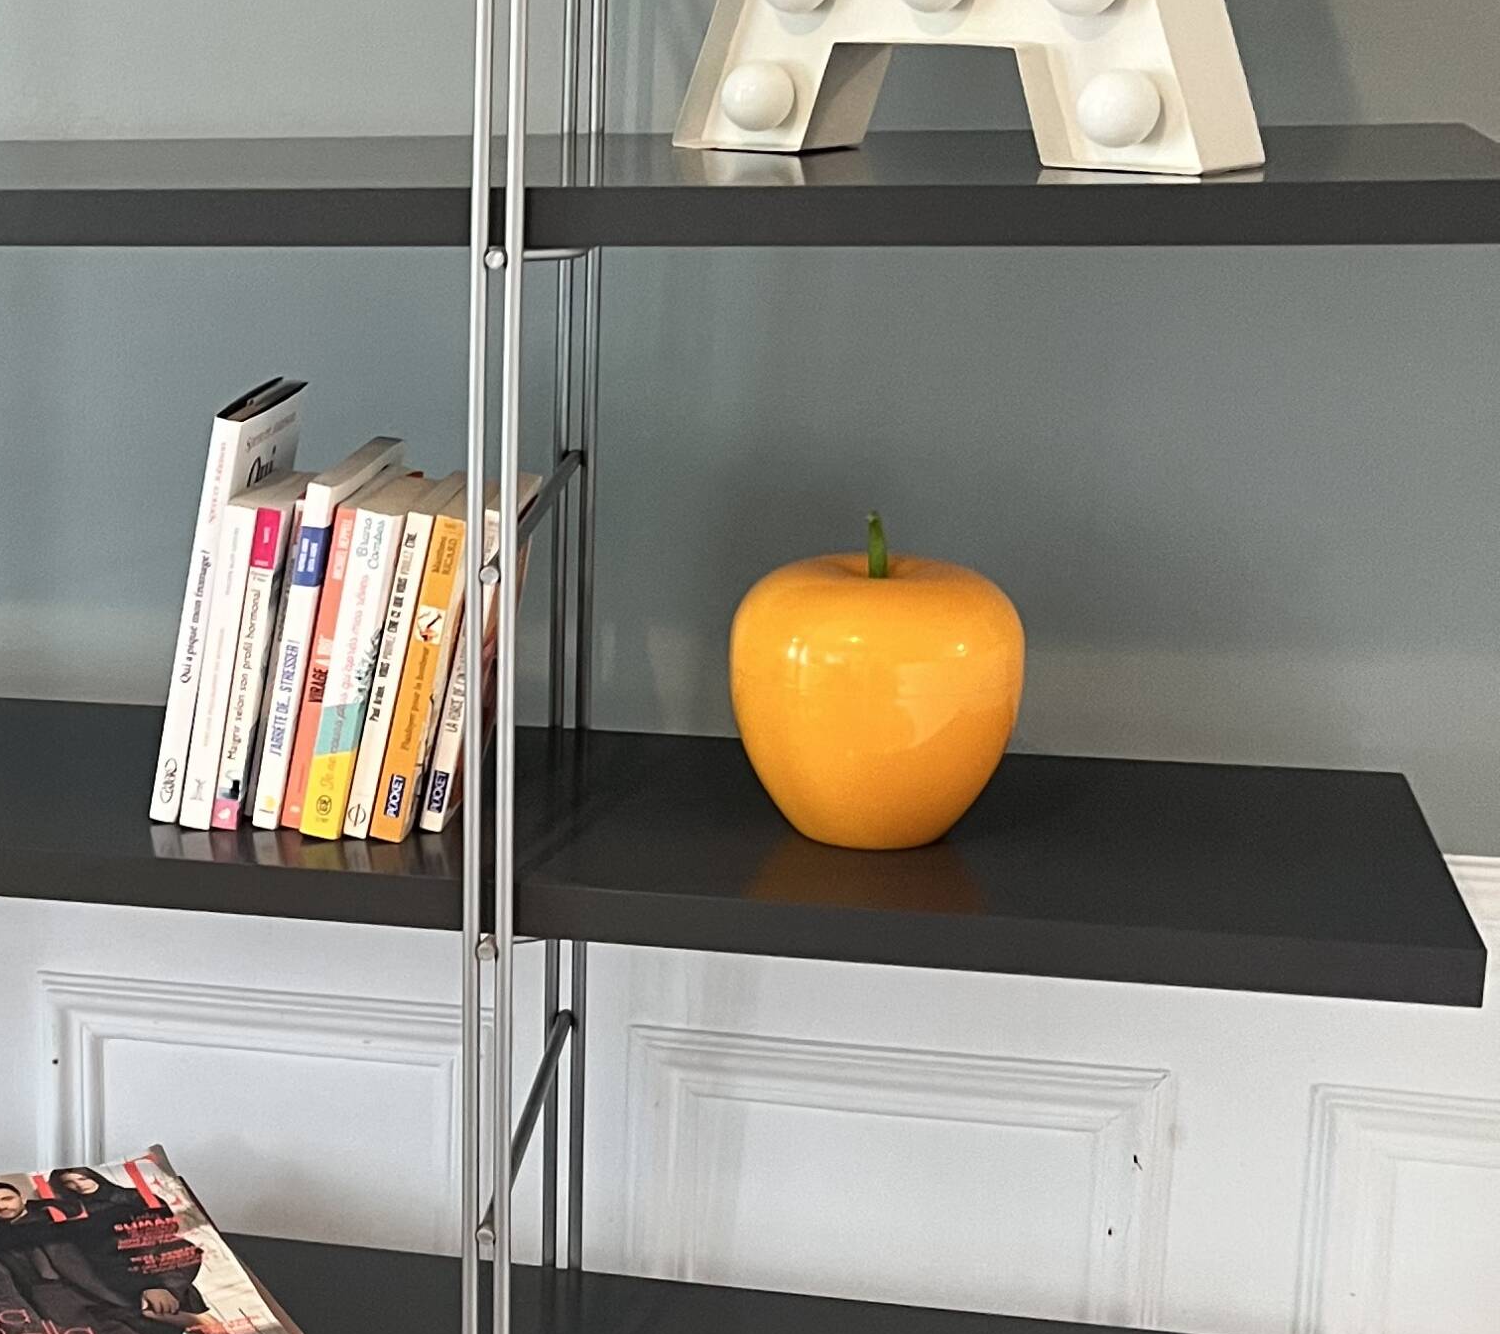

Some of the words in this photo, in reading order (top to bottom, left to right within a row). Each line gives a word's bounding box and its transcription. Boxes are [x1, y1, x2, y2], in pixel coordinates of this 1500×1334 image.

[246, 445, 277, 489] Qui
[356, 517, 372, 557] Bruno
[192, 599, 202, 624] mon
[245, 588, 261, 639] hormonal
[187, 625, 199, 656] piqué
[243, 642, 253, 670] profil
[180, 663, 192, 683] Qui
[241, 673, 249, 691] son
[279, 644, 300, 693] STRESSER
[308, 667, 329, 703] VIRAGE
[233, 694, 245, 722] selon
[227, 723, 242, 761] Maigrir
[387, 774, 405, 818] POCKET
[429, 772, 448, 813] POCKET
